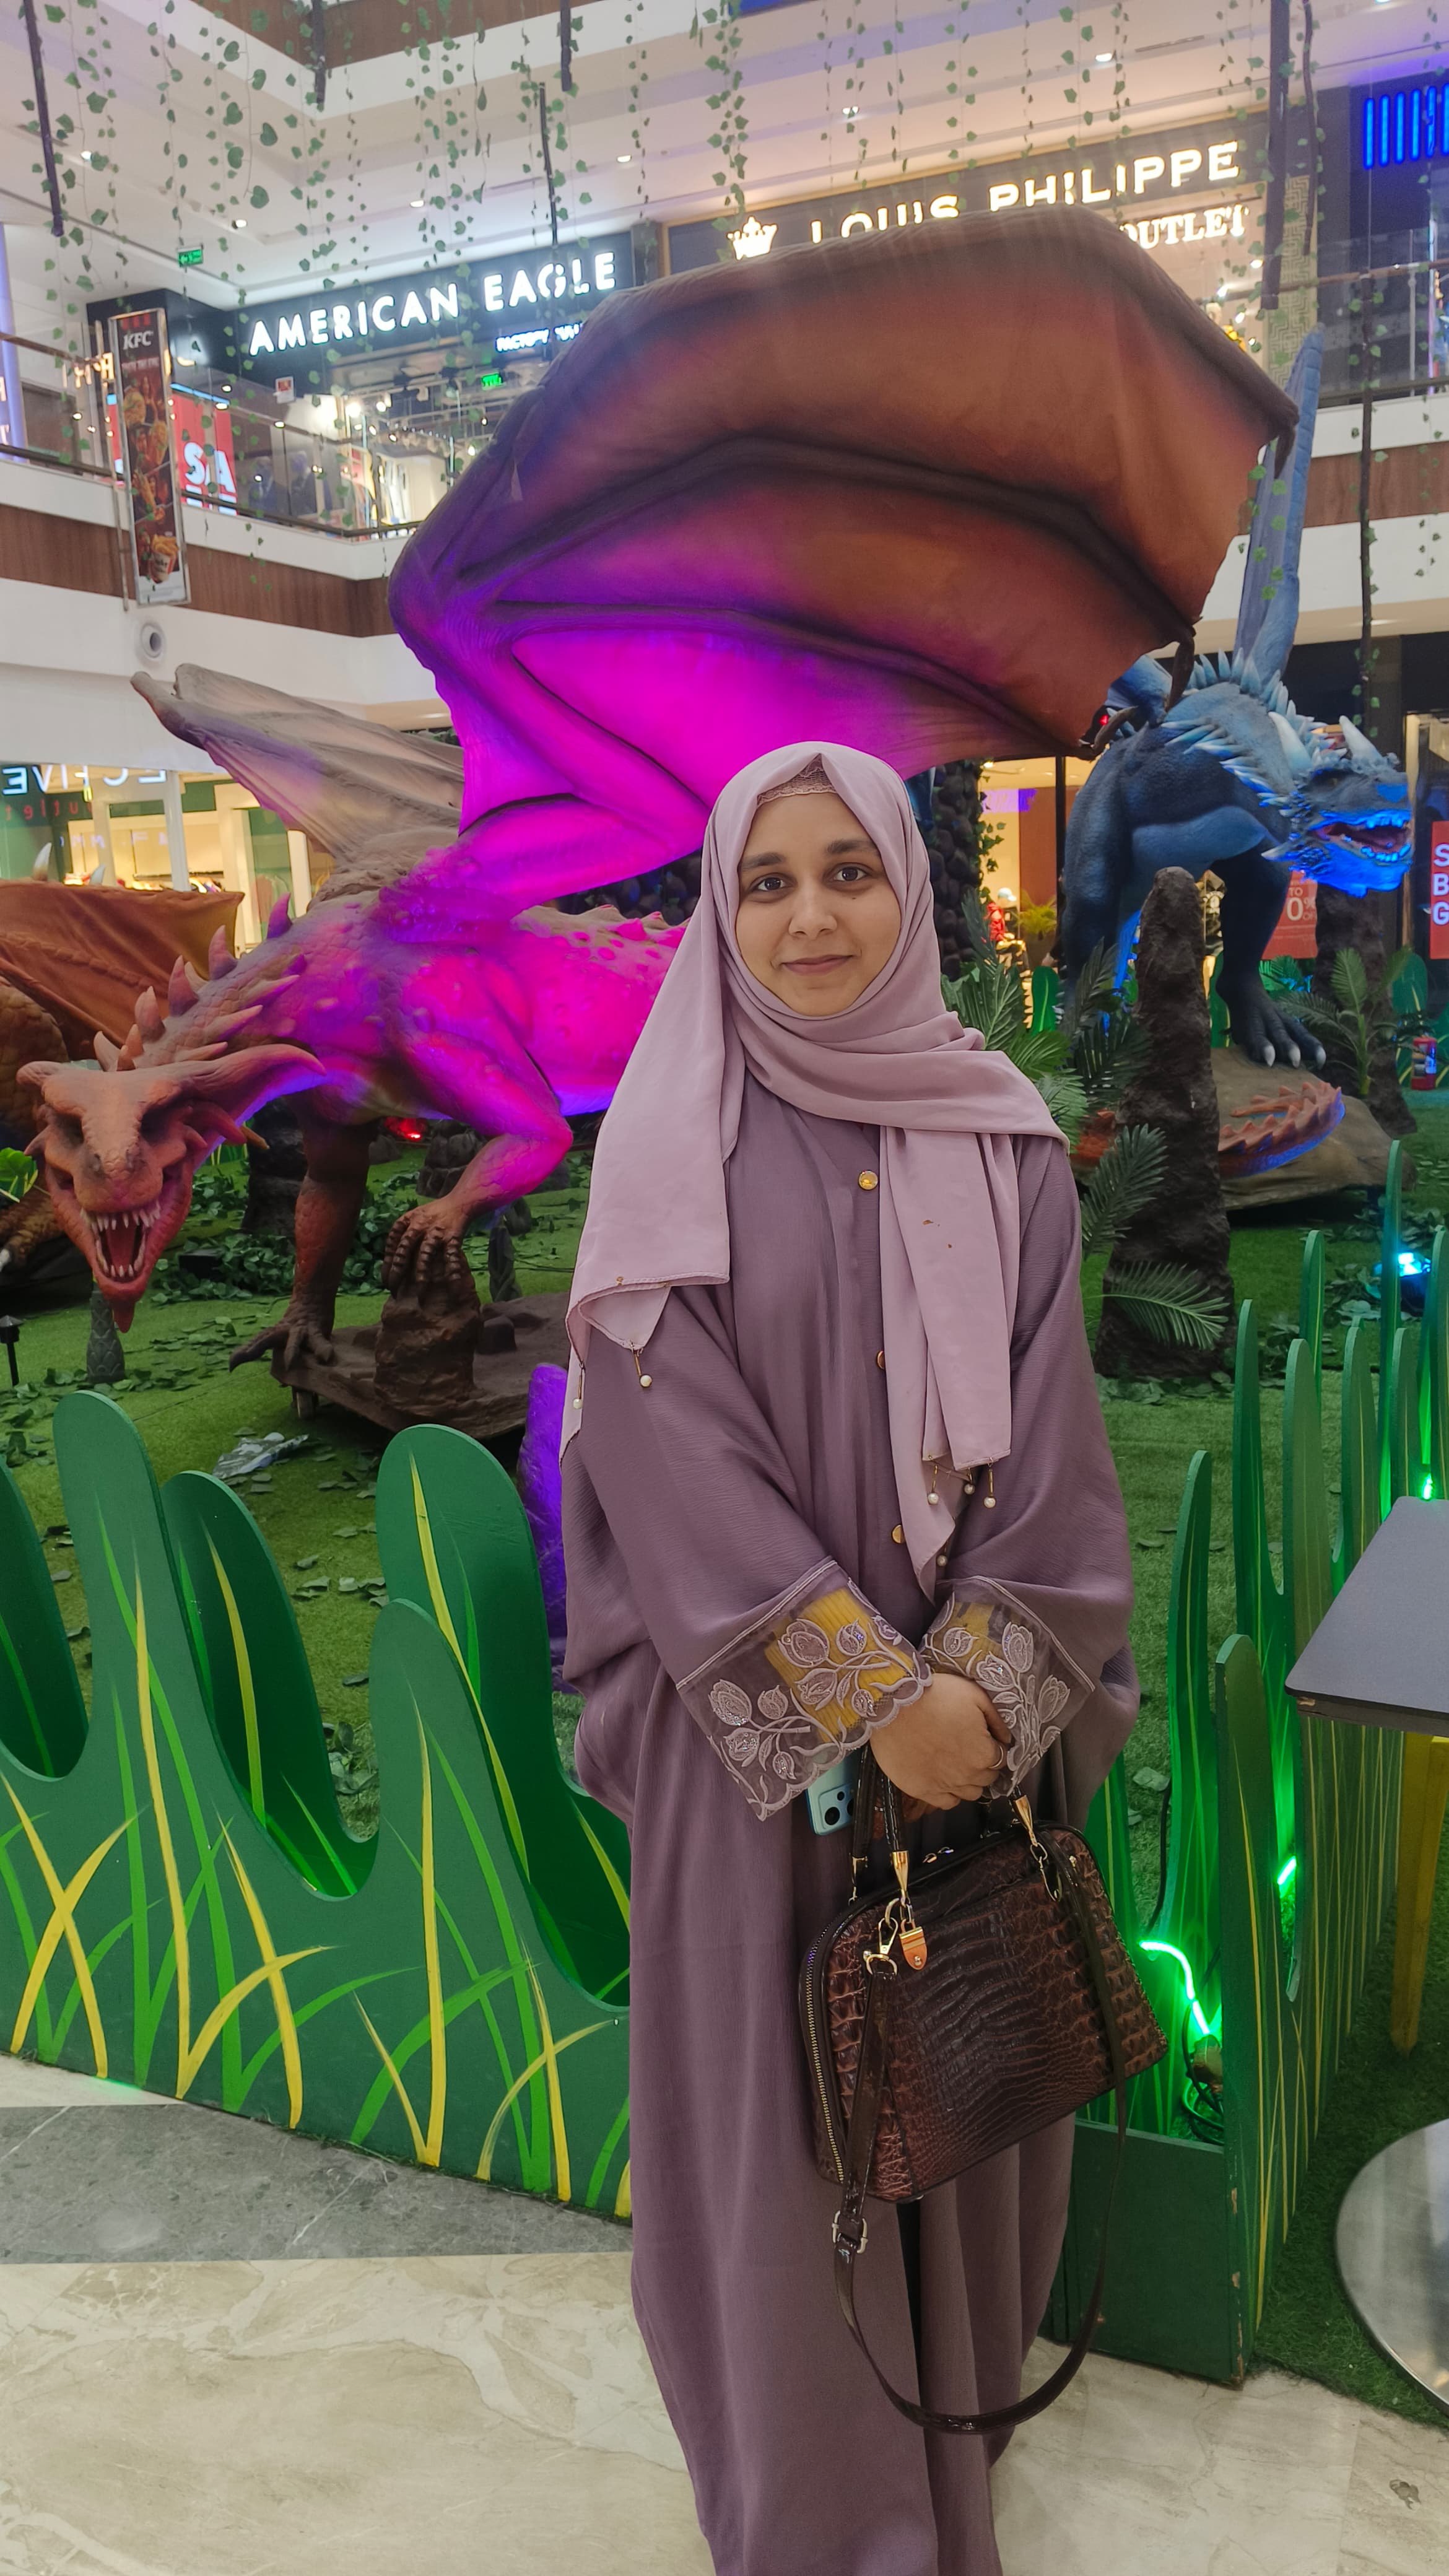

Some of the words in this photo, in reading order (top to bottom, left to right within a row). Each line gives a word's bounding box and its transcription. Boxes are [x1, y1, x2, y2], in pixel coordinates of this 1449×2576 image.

[989, 141, 1240, 212] PHILIPPE
[250, 283, 459, 356] AMERICAN
[484, 252, 616, 311] EAGLE
[123, 331, 154, 350] KFC
[1287, 897, 1315, 921] 0%
